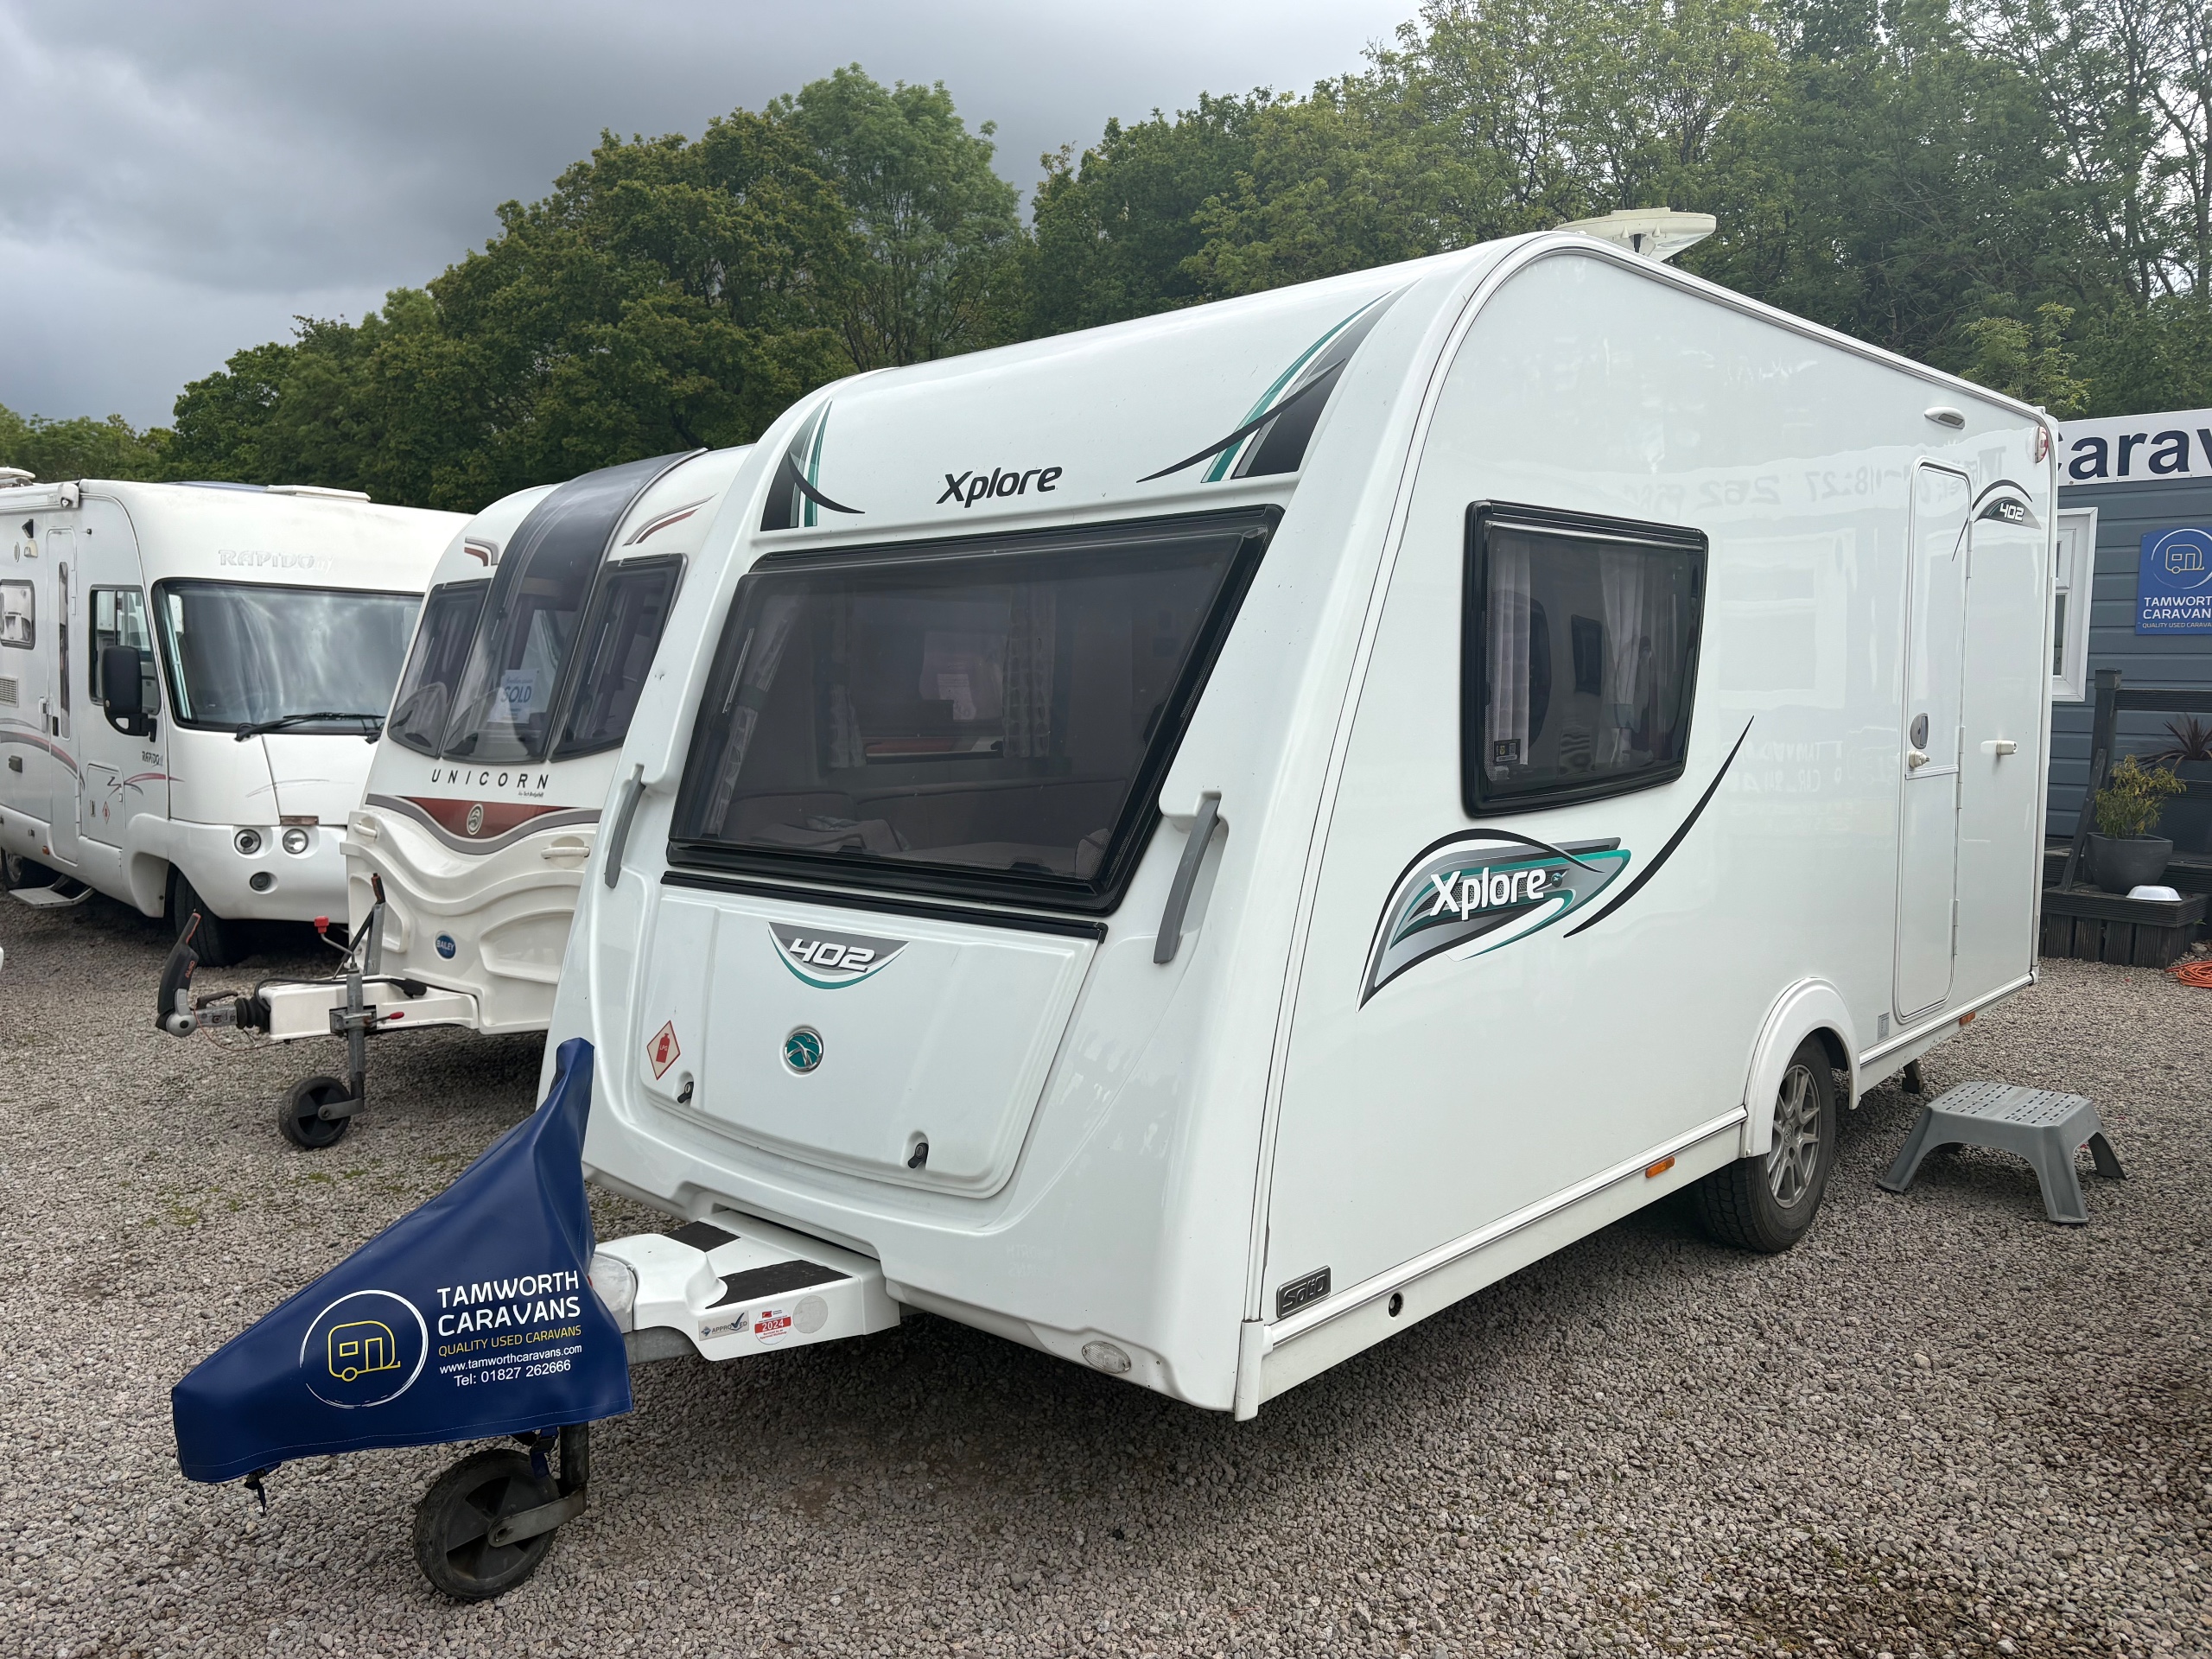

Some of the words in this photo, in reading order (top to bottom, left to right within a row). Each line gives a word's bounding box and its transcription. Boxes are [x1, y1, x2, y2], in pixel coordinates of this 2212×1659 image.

[936, 467, 1063, 508] Xplore
[1999, 502, 2024, 522] 402
[218, 550, 315, 569] RAPIDO
[500, 685, 532, 703] SOLD
[431, 768, 549, 790] UNICORN
[1429, 867, 1547, 921] Xplore
[436, 939, 455, 951] BAILEY
[789, 938, 876, 973] 402
[437, 1270, 579, 1308] TAMWORTH
[438, 1296, 581, 1337] CARAVANS
[711, 1313, 747, 1333] APPROVED
[762, 1319, 784, 1332] 2024
[438, 1338, 488, 1357] QUALITY
[491, 1334, 522, 1348] USED
[525, 1325, 582, 1344] CARAVANS
[440, 1345, 582, 1374] www.tamworthcaravans.com
[454, 1374, 476, 1387] Tel:
[481, 1367, 521, 1382] 01827
[525, 1359, 571, 1377] 262666
